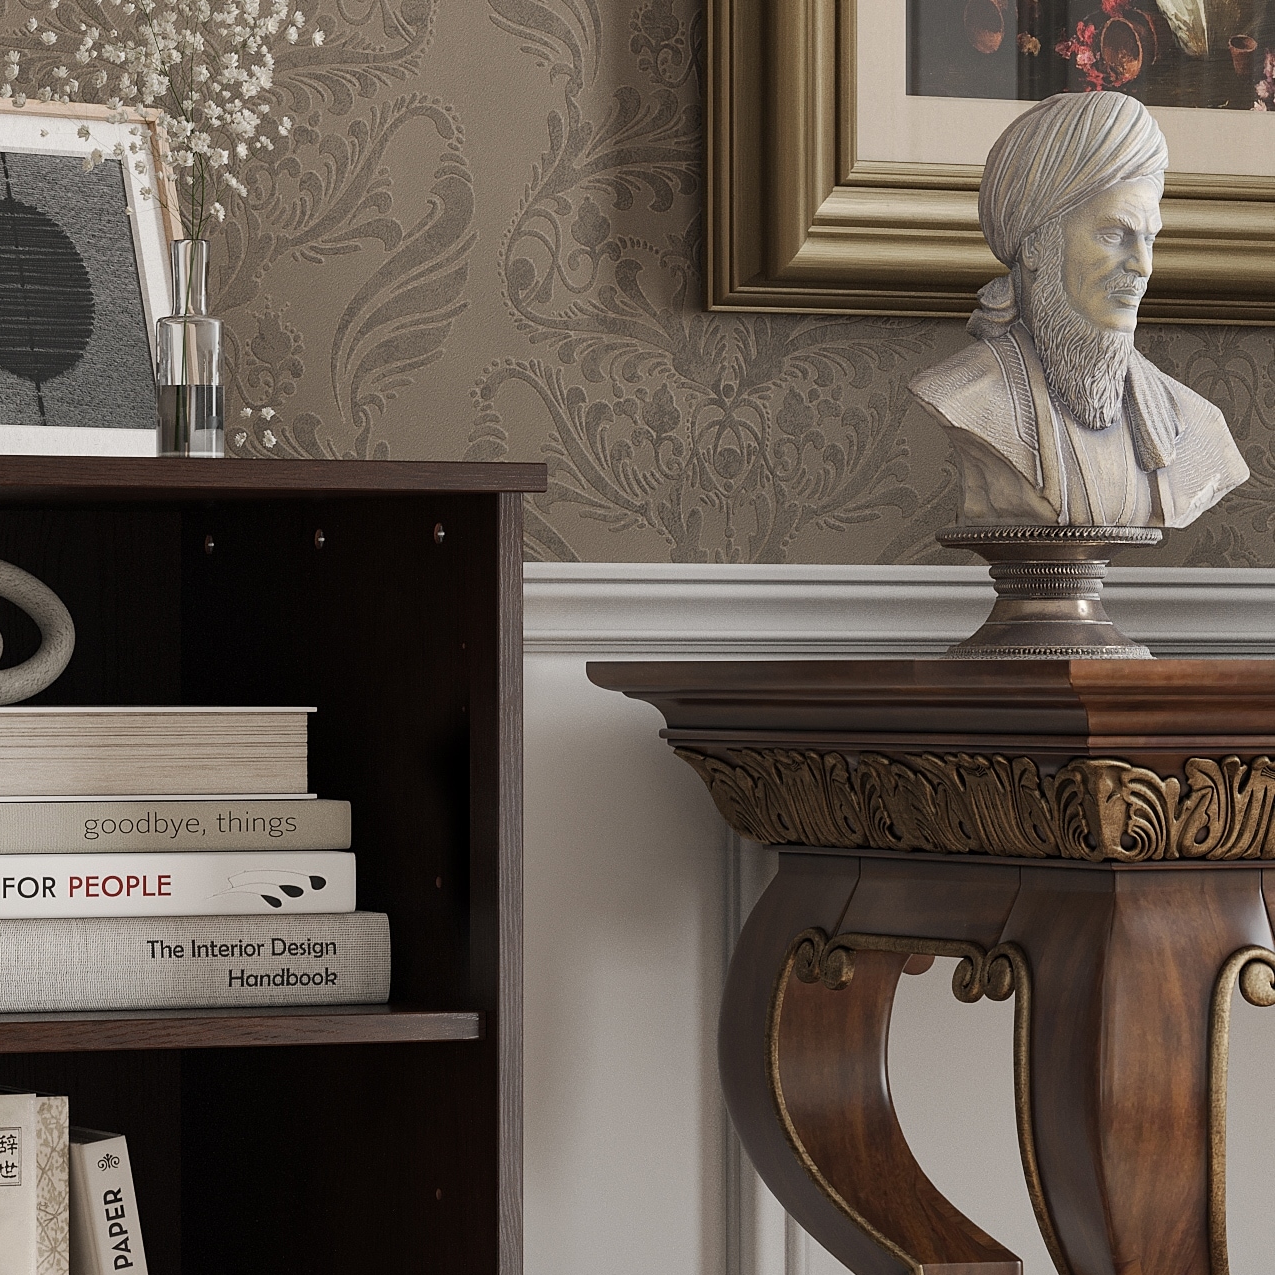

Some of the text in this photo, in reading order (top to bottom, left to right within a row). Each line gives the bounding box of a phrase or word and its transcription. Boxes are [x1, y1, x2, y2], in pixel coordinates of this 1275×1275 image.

[84, 811, 297, 839] goodbye, things
[2, 877, 56, 899] FOR
[69, 874, 172, 898] PEOPLE
[147, 937, 337, 962] The Interior Design
[228, 967, 337, 988] Handbook
[103, 1187, 134, 1271] PAPER
